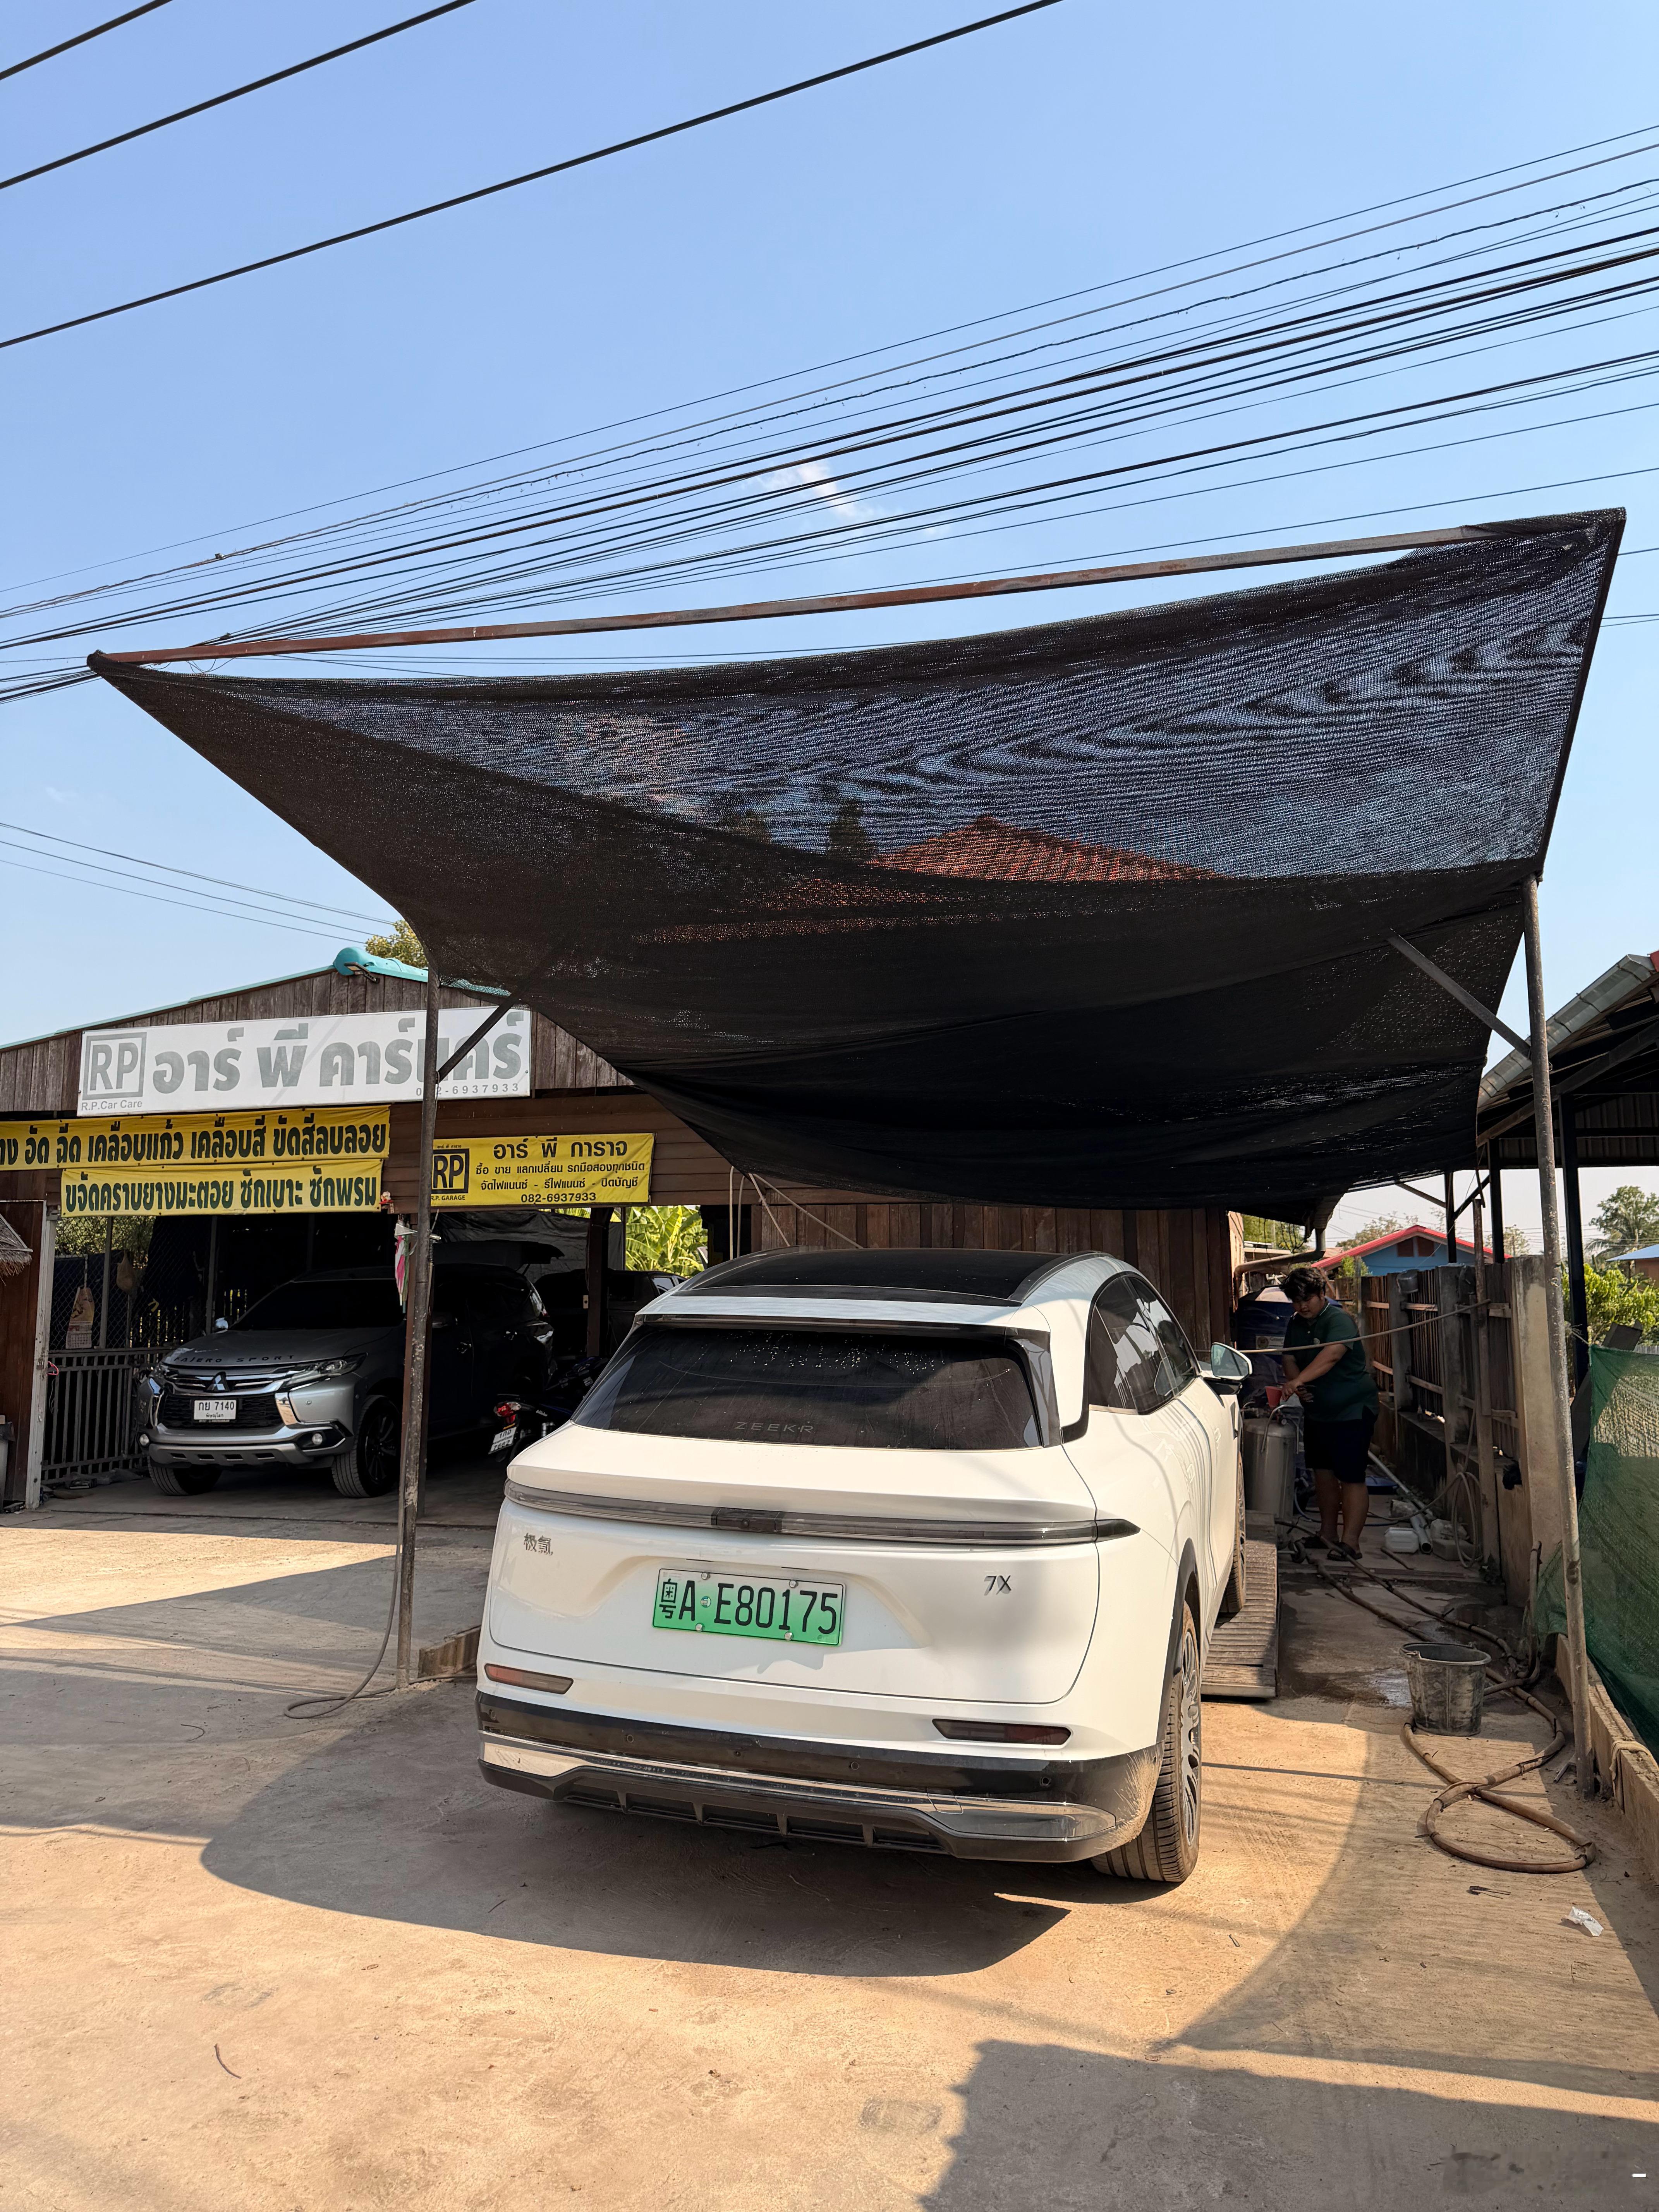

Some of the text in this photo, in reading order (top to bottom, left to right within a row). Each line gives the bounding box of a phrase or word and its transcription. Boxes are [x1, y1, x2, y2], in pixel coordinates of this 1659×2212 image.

[90, 1042, 138, 1091] RP
[153, 1027, 244, 1094] อาร์
[256, 1023, 309, 1088] พี
[416, 1083, 519, 1096] 02-6937933
[81, 1099, 143, 1111] R.P.Car Care
[25, 1125, 50, 1164] อัด
[57, 1123, 81, 1163] ฉีด
[88, 1119, 184, 1162] เคลือบแก้ว
[191, 1115, 266, 1159] เคลือบสี
[273, 1113, 386, 1157] ขัดสีลบลอย
[493, 1137, 628, 1159] อาร์ พี การาจ
[433, 1155, 464, 1188] RP
[476, 1163, 489, 1175] ซื้อ
[517, 1161, 563, 1174] แลกเปลี่ยน
[567, 1161, 645, 1173] รถมือสองทุกชนิด
[66, 1165, 376, 1212] ขจัดคราบยางมะตอย ซักเบาะ ซักพรม
[481, 1179, 528, 1190] จัดไฟแนนซ์
[544, 1178, 586, 1189] รีไฟแนนซ์
[601, 1176, 638, 1188] ปิดบัญชี
[521, 1192, 596, 1202] 082-6937933
[199, 1401, 234, 1410] กย 7140
[734, 1422, 814, 1433] ZEEKR
[984, 1575, 1012, 1595] 7X
[714, 1583, 838, 1635] E80175
